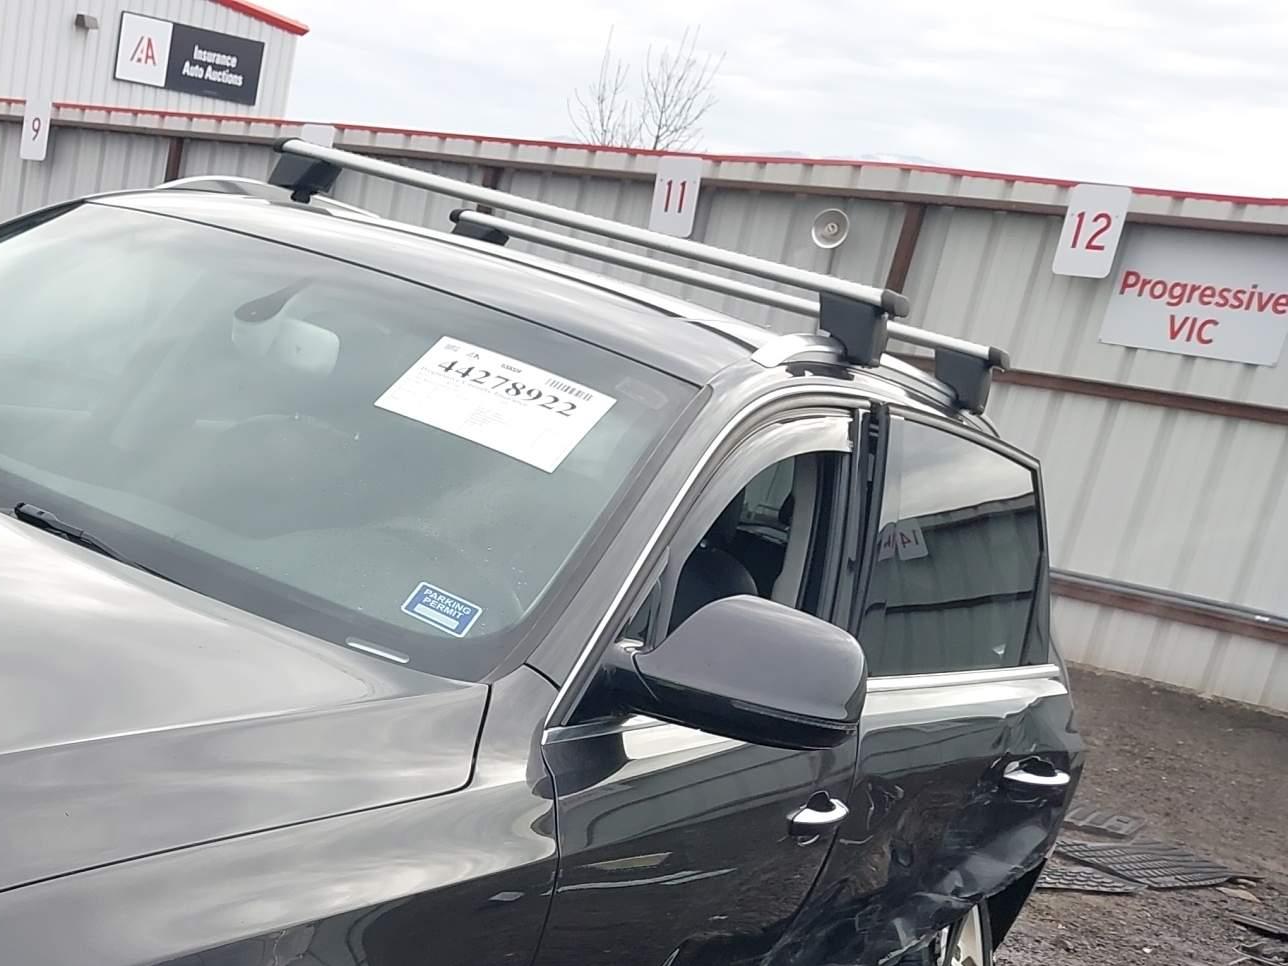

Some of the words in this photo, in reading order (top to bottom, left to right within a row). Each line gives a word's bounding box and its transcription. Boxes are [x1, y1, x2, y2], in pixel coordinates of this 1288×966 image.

[193, 44, 237, 68] Insurance
[182, 61, 205, 79] Auto
[204, 65, 243, 86] Auctions
[31, 119, 41, 142] 9
[665, 179, 687, 213] 11
[1070, 211, 1112, 251] 12
[1119, 270, 1288, 314] Progressive
[1168, 313, 1220, 345] VIC
[438, 360, 577, 417] 44278922
[422, 596, 464, 619] PERMIT
[423, 588, 472, 615] PARKING
